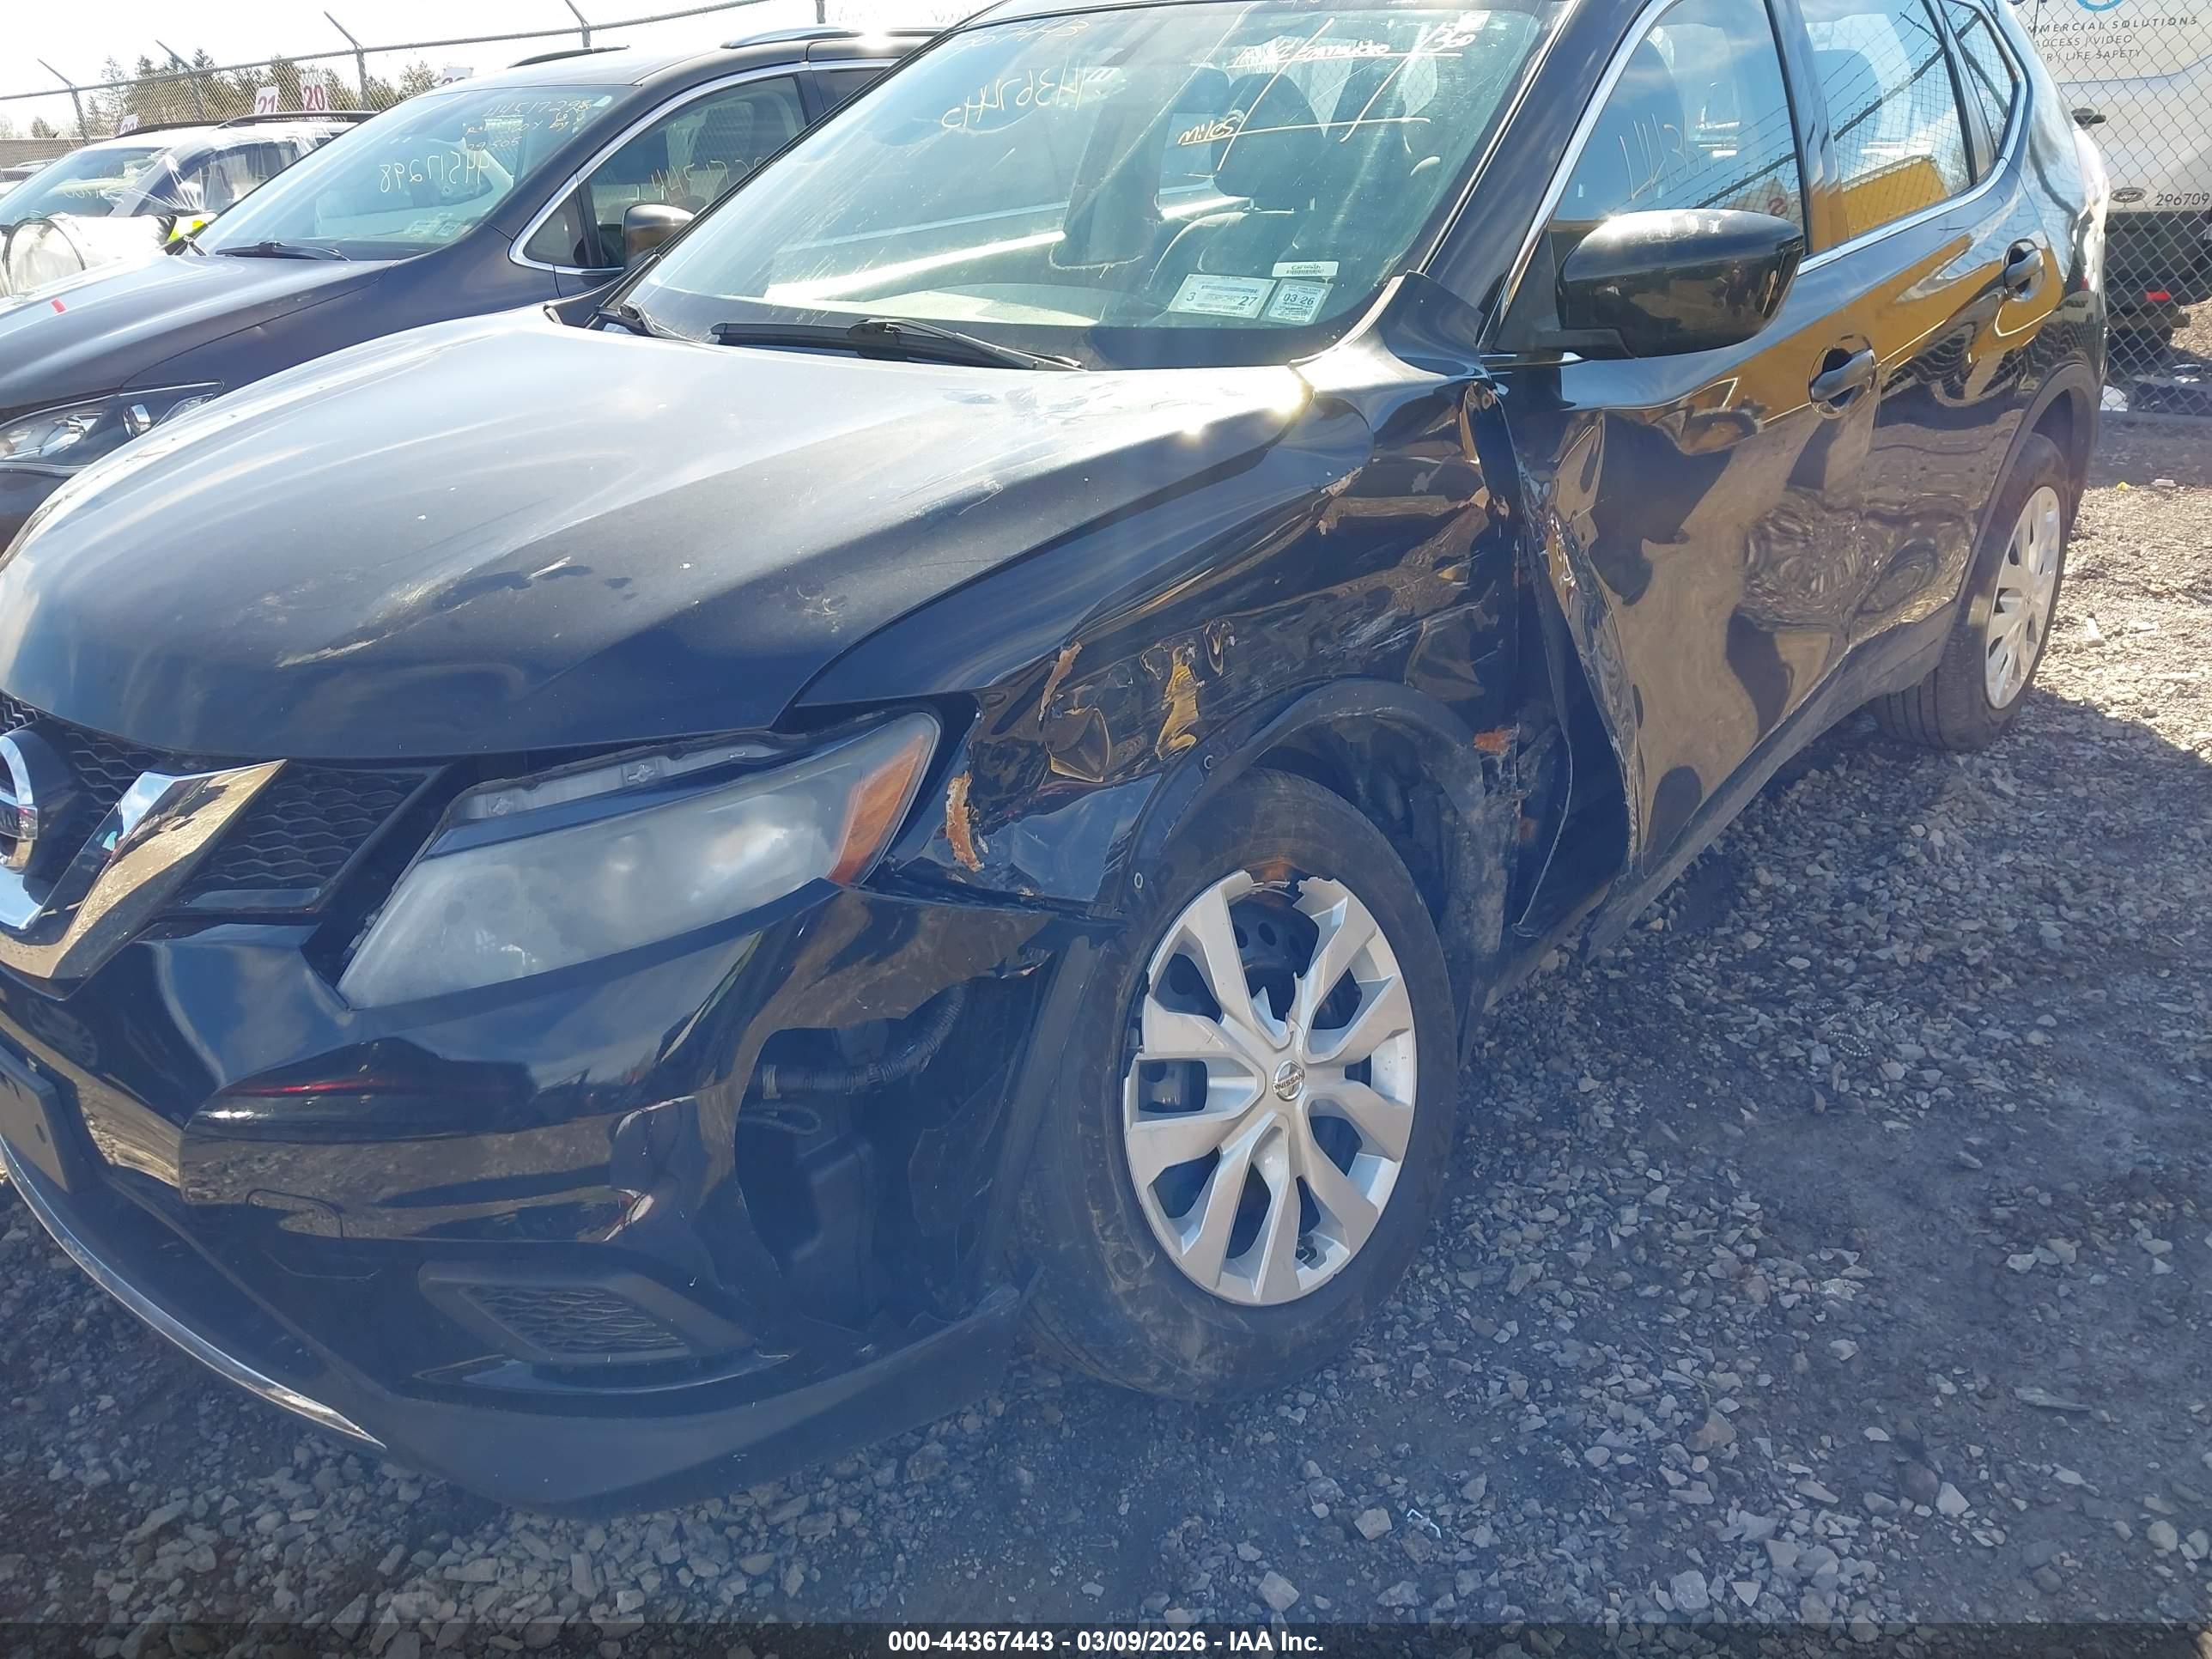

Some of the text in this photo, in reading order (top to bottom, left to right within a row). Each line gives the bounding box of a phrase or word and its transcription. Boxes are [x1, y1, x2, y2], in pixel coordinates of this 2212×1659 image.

[2027, 15, 2198, 34] MMERCIAL SOLUTIONS
[2093, 34, 2134, 46] VIDEO
[2065, 51, 2091, 61] LIFE
[2096, 49, 2142, 60] SAFETY
[258, 94, 276, 113] 21
[303, 85, 325, 111] 20
[1186, 291, 1197, 302] 3
[1237, 295, 1259, 307] 27
[1283, 293, 1298, 303] 03
[1299, 295, 1316, 306] 26
